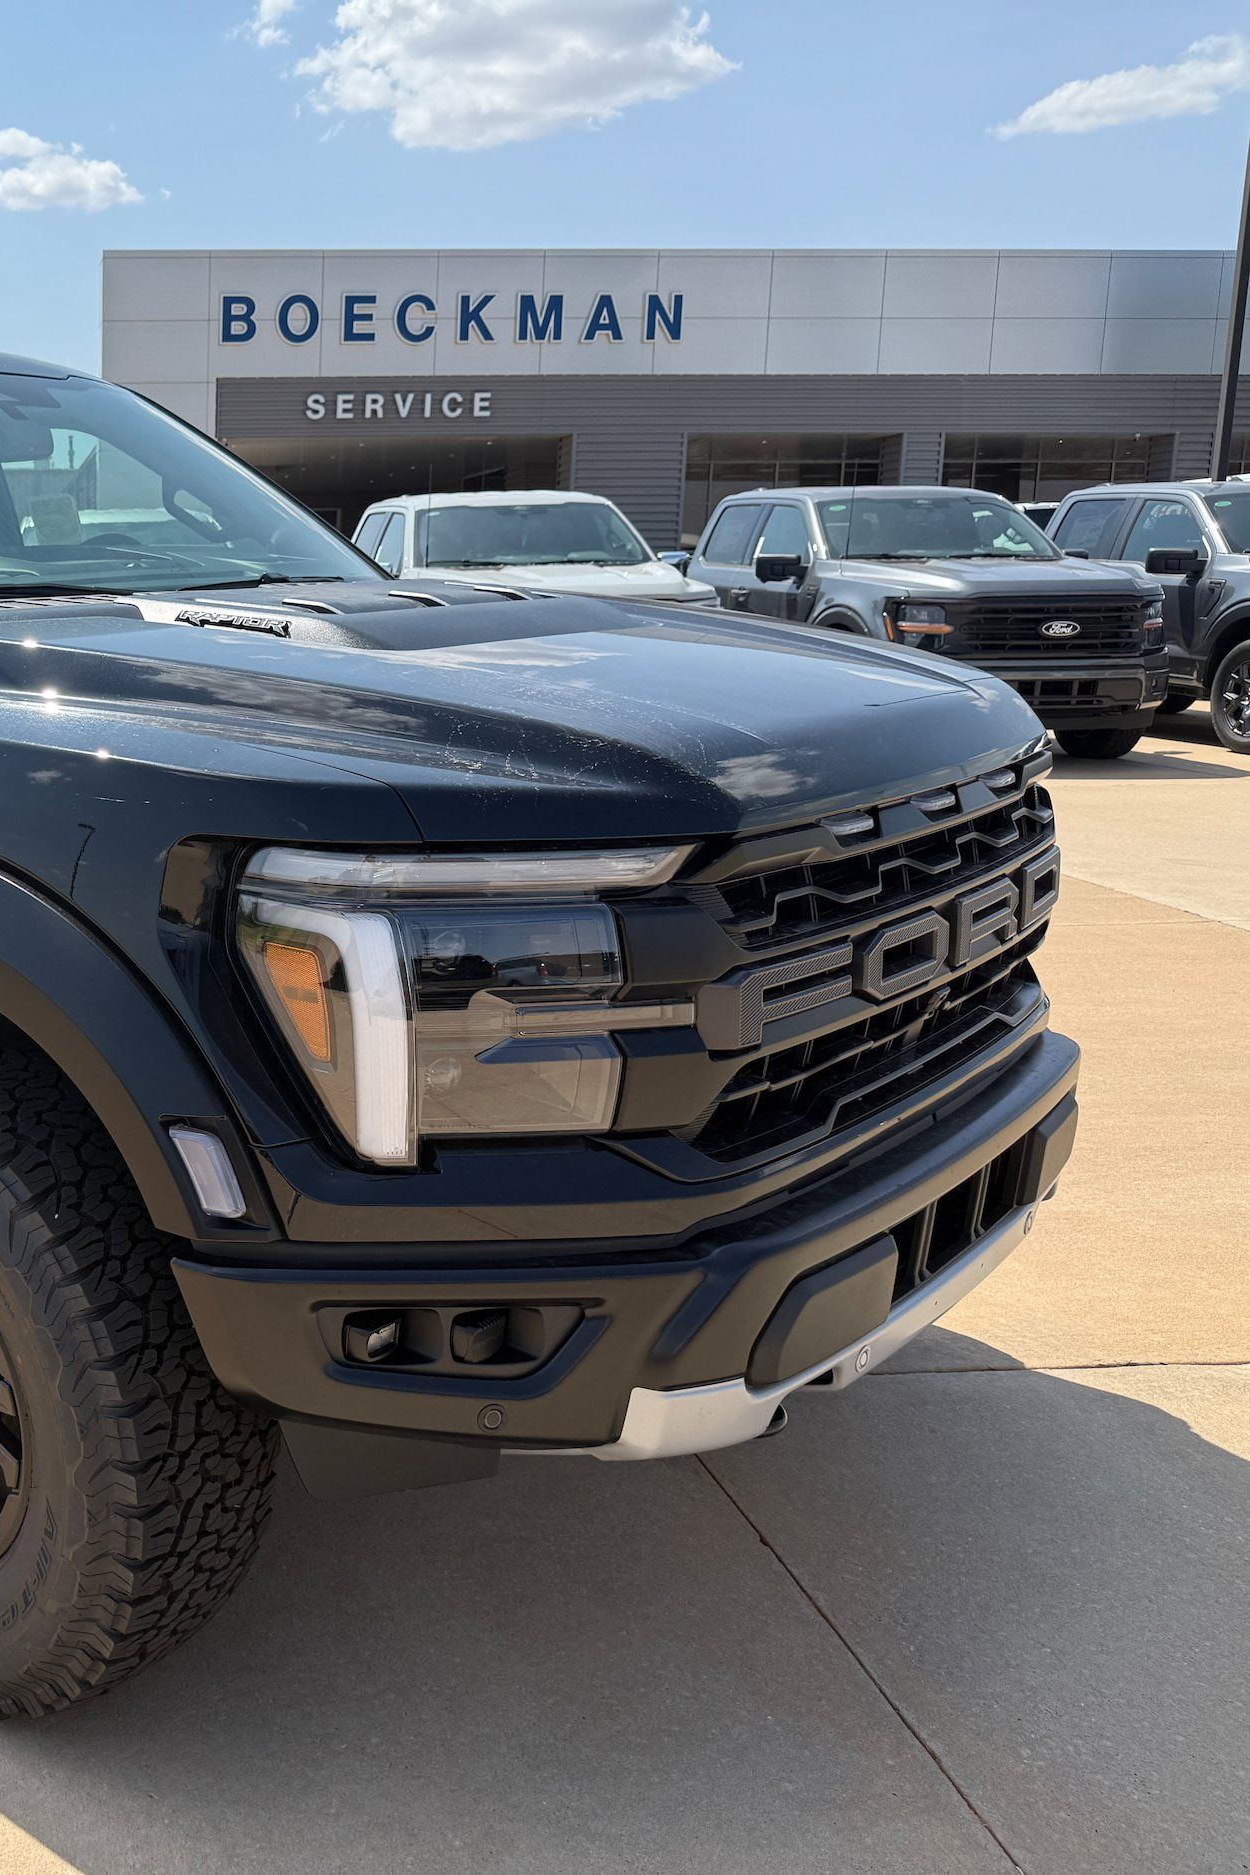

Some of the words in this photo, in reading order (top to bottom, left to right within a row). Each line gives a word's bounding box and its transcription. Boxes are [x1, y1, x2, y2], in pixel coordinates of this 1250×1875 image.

[218, 291, 685, 346] BOECKMAN
[305, 391, 492, 420] SERVICE
[175, 609, 293, 639] RAPTOR
[1046, 622, 1077, 635] Ford
[697, 845, 1061, 1054] FORD
